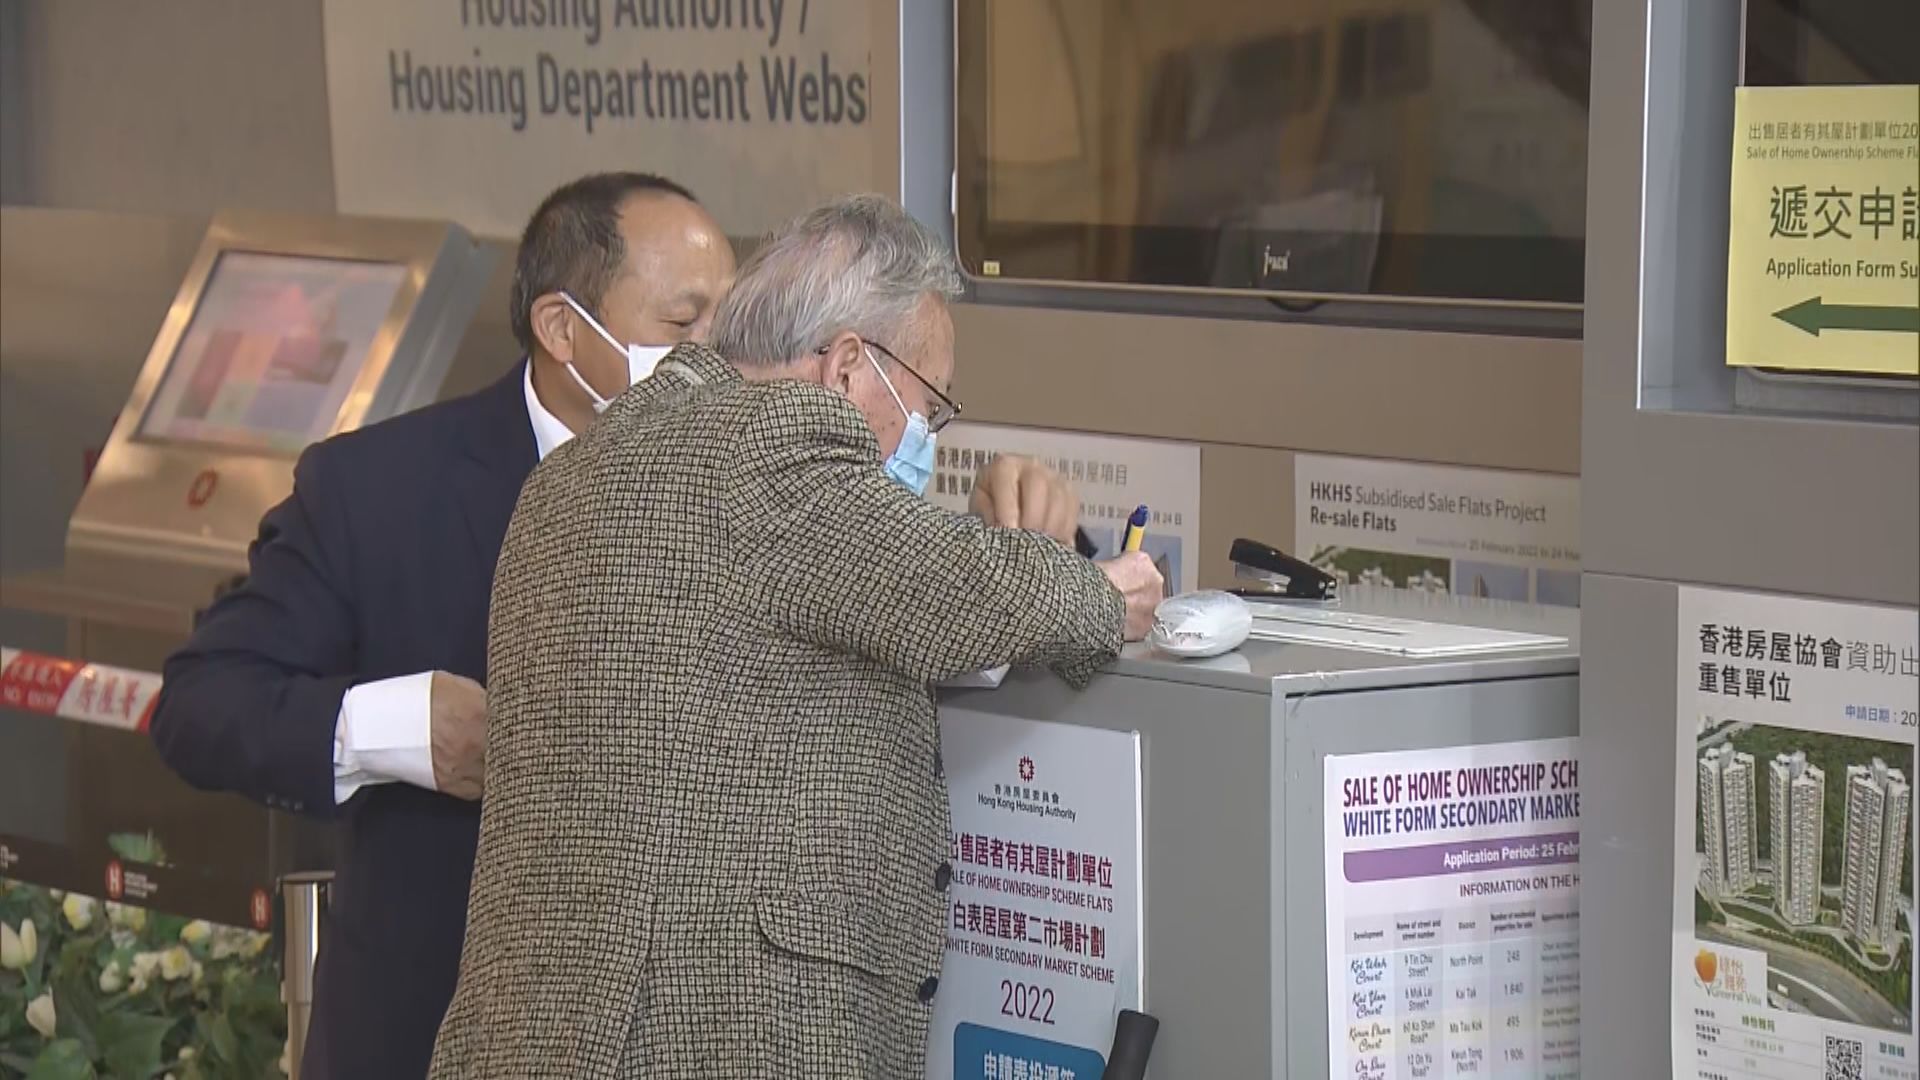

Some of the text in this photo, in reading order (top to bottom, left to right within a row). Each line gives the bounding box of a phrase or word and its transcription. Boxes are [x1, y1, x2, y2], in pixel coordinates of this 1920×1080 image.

[389, 50, 527, 130] Housing
[537, 53, 750, 133] Department
[1747, 147, 1766, 159] Sale
[1769, 146, 1778, 159] of
[1782, 147, 1809, 159] Home
[1812, 146, 1863, 161] Ownership
[1867, 146, 1904, 159] Scheme
[1766, 258, 1851, 279] Application
[1856, 260, 1895, 278] Form
[1310, 482, 1546, 523] HKHS Subsidised Sale Flats Project
[1310, 506, 1396, 532] Re-sale Flats
[1698, 662, 1791, 702] 重售單位
[1343, 759, 1578, 807] SALE OF HOME OWNERSHIP SCH
[978, 794, 1077, 822] Hong Kong Housing Authority
[1344, 792, 1579, 837] WHITE FORM SECONDARY MARKE
[1443, 848, 1500, 869] Application
[1502, 844, 1539, 860] Period:
[1541, 843, 1555, 857] 25
[966, 872, 976, 887] OF
[978, 875, 1001, 891] HOME
[1003, 878, 1050, 898] OWNERSHIP
[1052, 888, 1086, 907] SCHEME
[1087, 897, 1113, 913] FLATS
[1460, 880, 1531, 897] INFORMATION
[1533, 877, 1548, 889] ON
[1550, 874, 1571, 888] THE
[953, 899, 1105, 959] 白表居屋第二市場計劃
[971, 943, 993, 959] FORM
[995, 946, 1043, 969] SECONDARY
[1045, 957, 1078, 976] MARKET
[1080, 964, 1114, 984] SCHEME
[1001, 980, 1055, 1024] 2022
